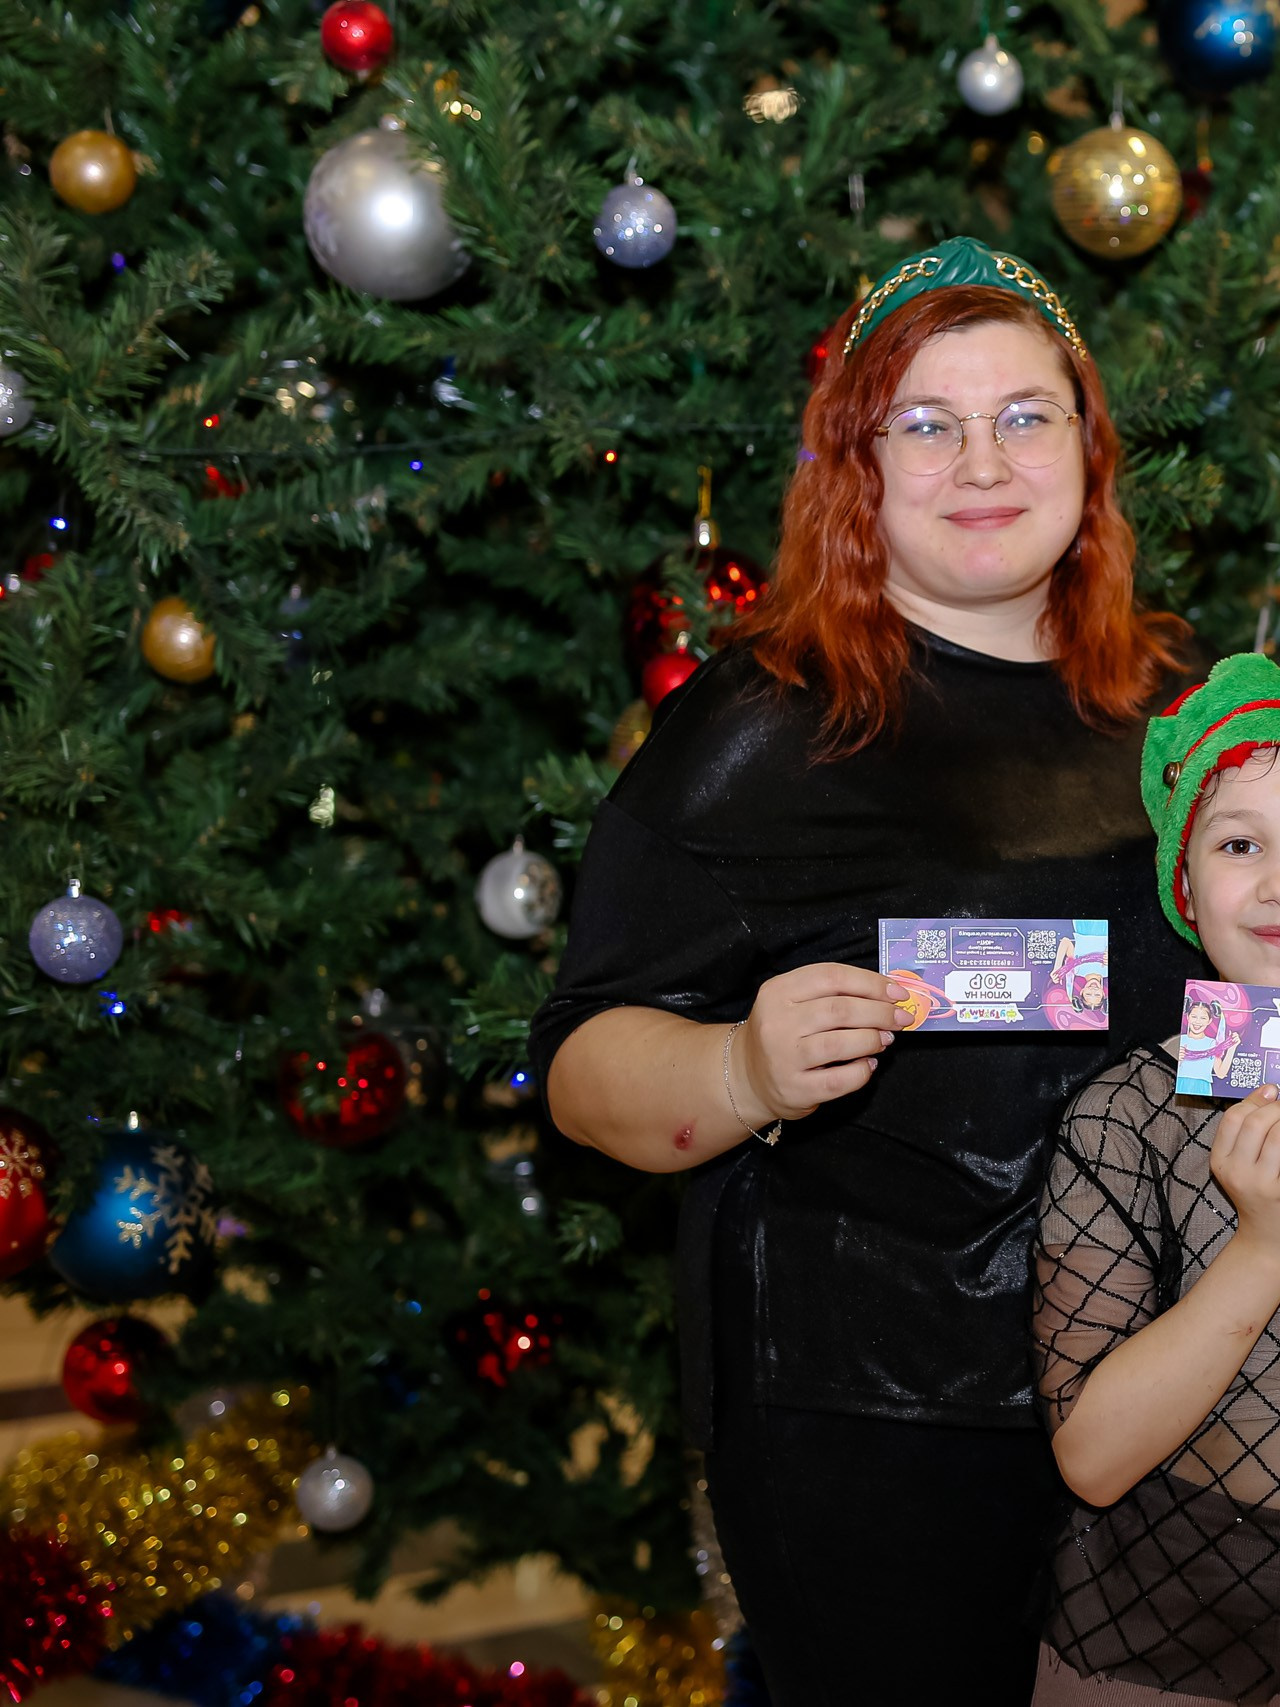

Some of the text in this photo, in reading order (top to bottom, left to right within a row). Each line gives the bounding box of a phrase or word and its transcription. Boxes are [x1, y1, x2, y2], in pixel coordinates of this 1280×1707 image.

[984, 974, 1007, 990] 50
[965, 991, 1012, 999] КУПОН НА
